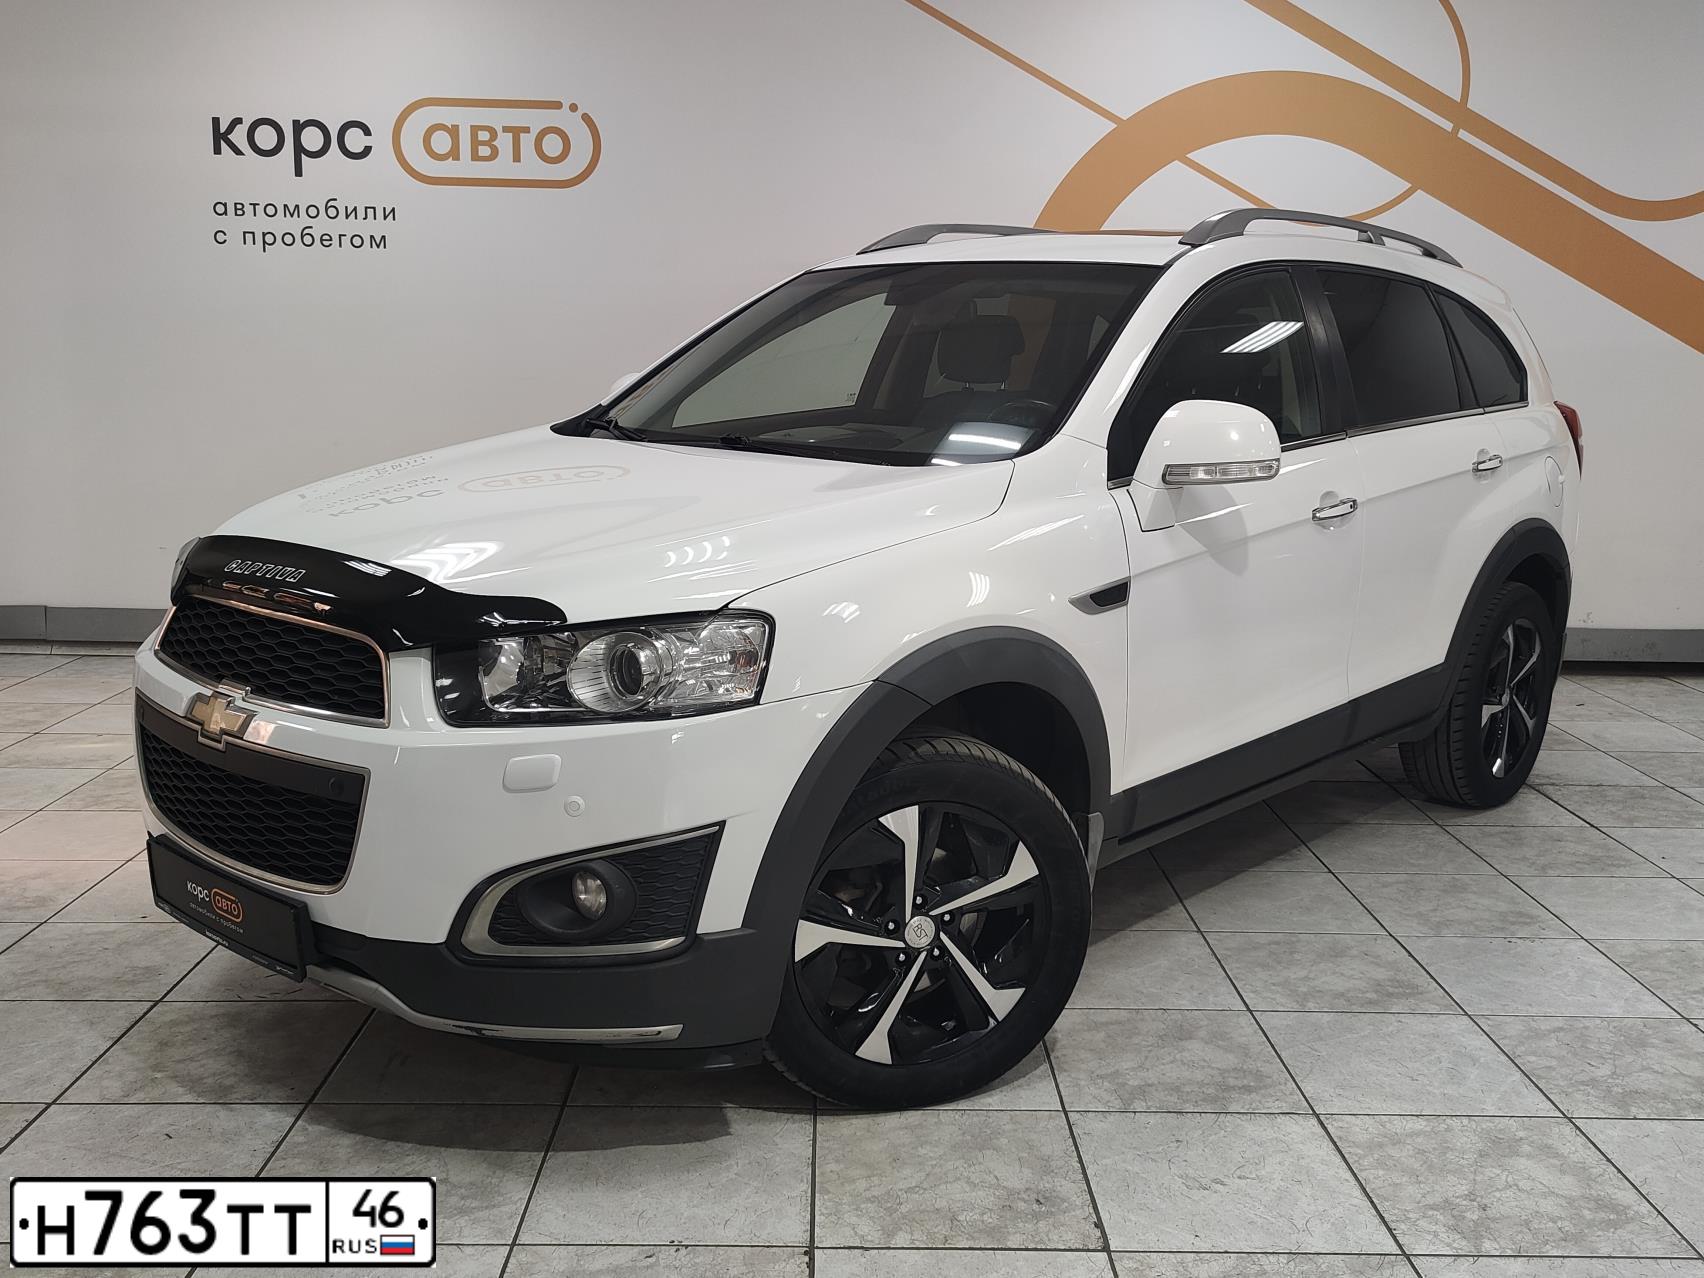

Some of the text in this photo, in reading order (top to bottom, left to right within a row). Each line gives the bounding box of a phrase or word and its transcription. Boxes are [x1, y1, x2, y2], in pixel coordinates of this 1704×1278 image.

[211, 116, 571, 178] корс авто
[212, 198, 397, 222] автомобили
[213, 226, 388, 253] с пробегом
[224, 559, 307, 582] CAPTIVA
[186, 880, 210, 902] корс
[215, 895, 238, 915] авто
